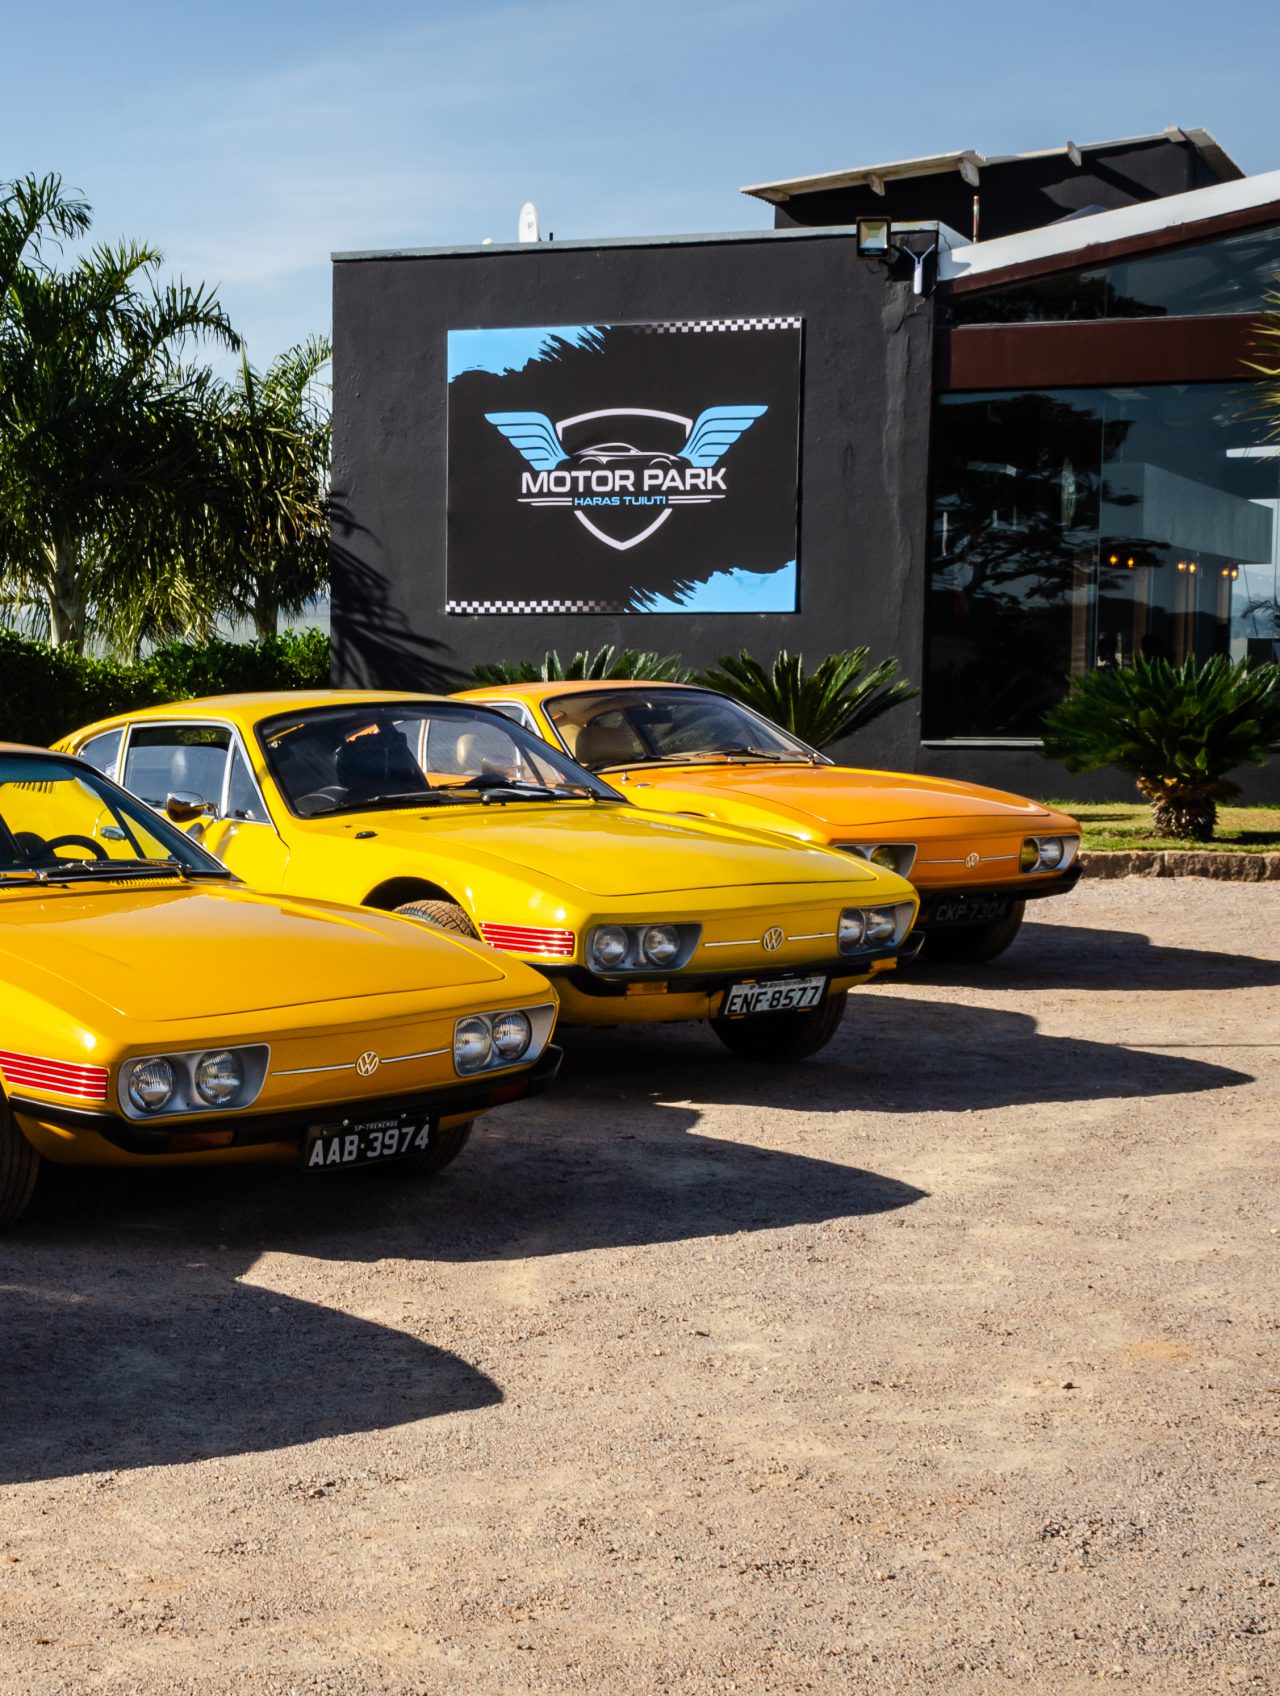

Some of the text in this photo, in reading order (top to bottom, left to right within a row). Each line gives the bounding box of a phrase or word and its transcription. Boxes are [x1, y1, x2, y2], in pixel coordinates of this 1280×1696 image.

[521, 467, 727, 494] MOTOR PARK
[574, 495, 667, 506] HARAS TUIUTI
